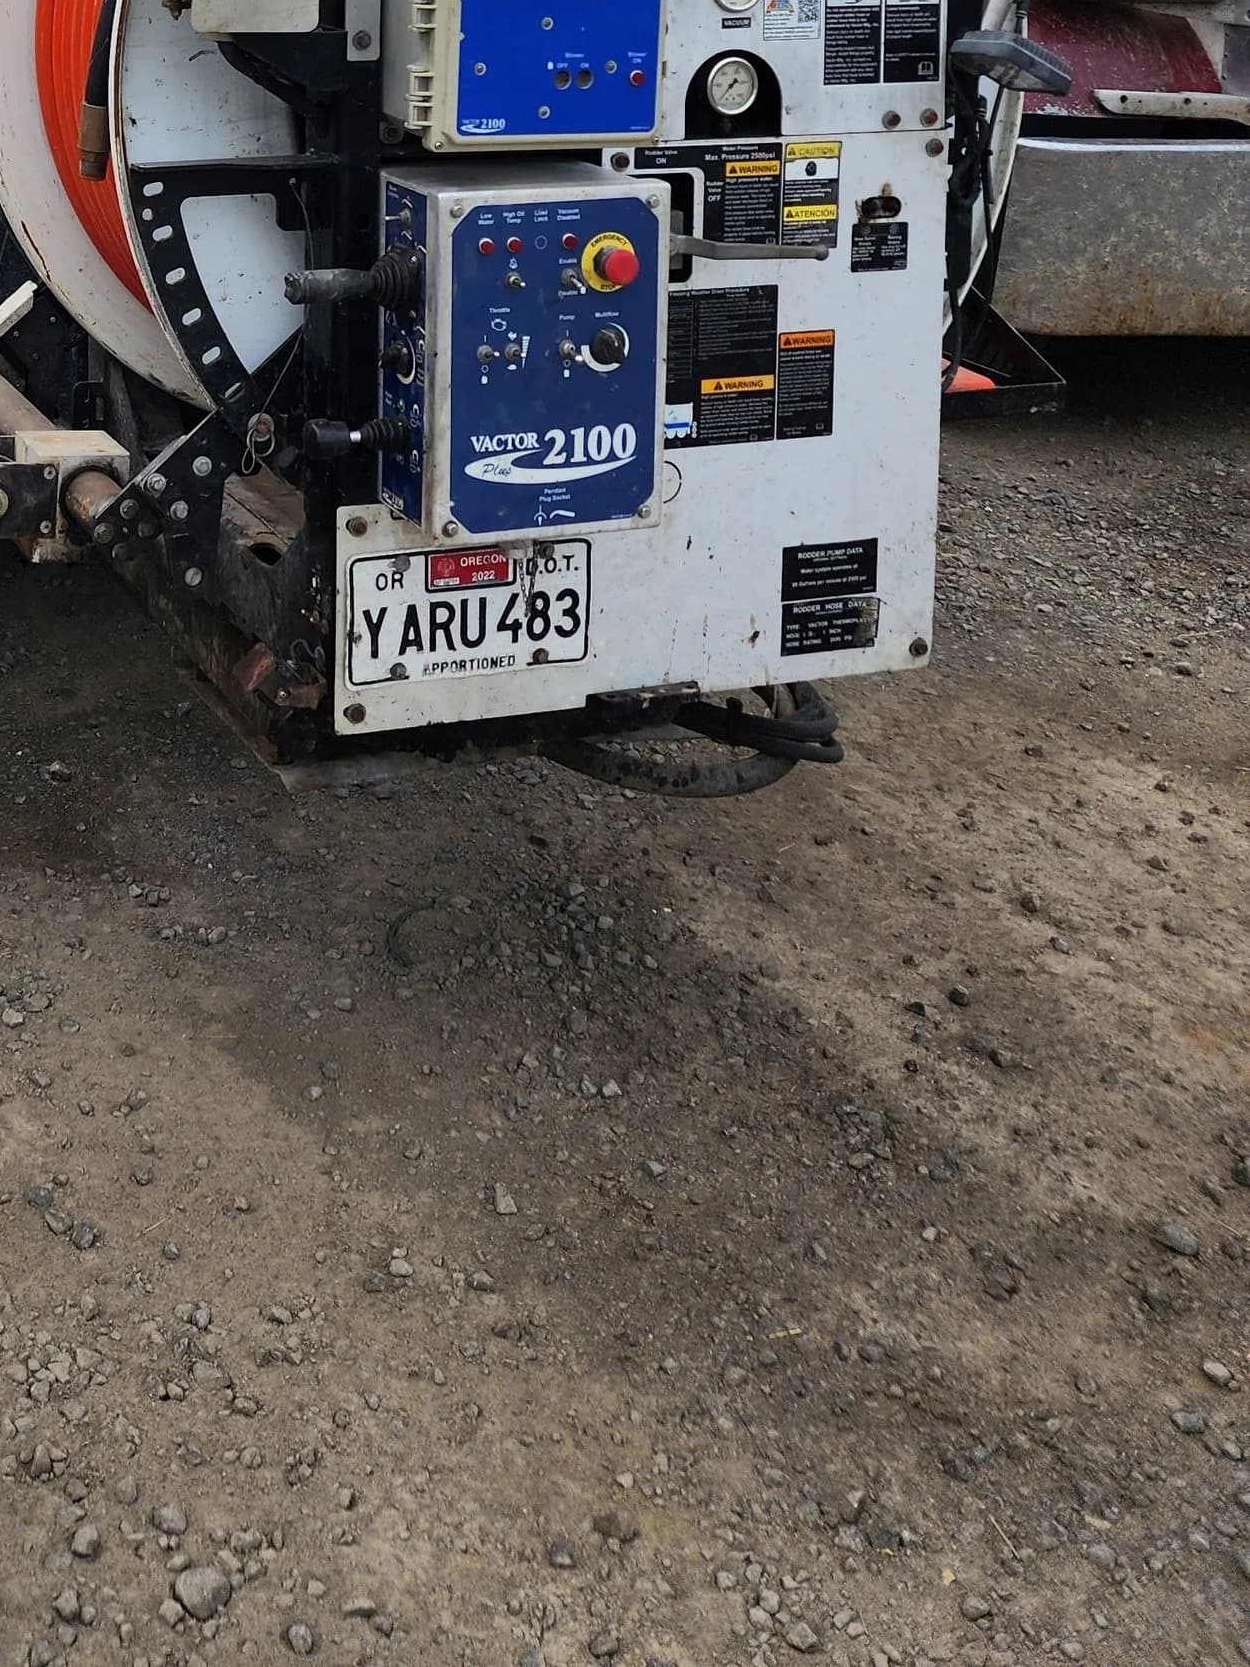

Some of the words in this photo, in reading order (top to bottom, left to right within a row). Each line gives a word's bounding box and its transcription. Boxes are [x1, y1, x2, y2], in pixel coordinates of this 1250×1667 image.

[724, 19, 750, 27] VACUUM
[481, 118, 506, 129] 2100
[799, 147, 834, 155] CAUTION
[738, 164, 778, 173] WARNING
[796, 208, 835, 218] ATENCIÓN
[591, 234, 628, 248] EMERGENCY
[792, 336, 832, 345] WARNING
[724, 380, 763, 390] WARNING
[470, 432, 540, 453] VACTOR
[543, 423, 636, 465] 2100
[482, 463, 512, 476] Plus
[460, 554, 507, 566] OREGON
[798, 550, 825, 559] RODDER
[472, 570, 495, 582] 2022
[376, 573, 404, 591] OR
[793, 604, 821, 614] RODDER
[824, 602, 843, 610] HOSE
[422, 655, 516, 676] APPORTIONED
